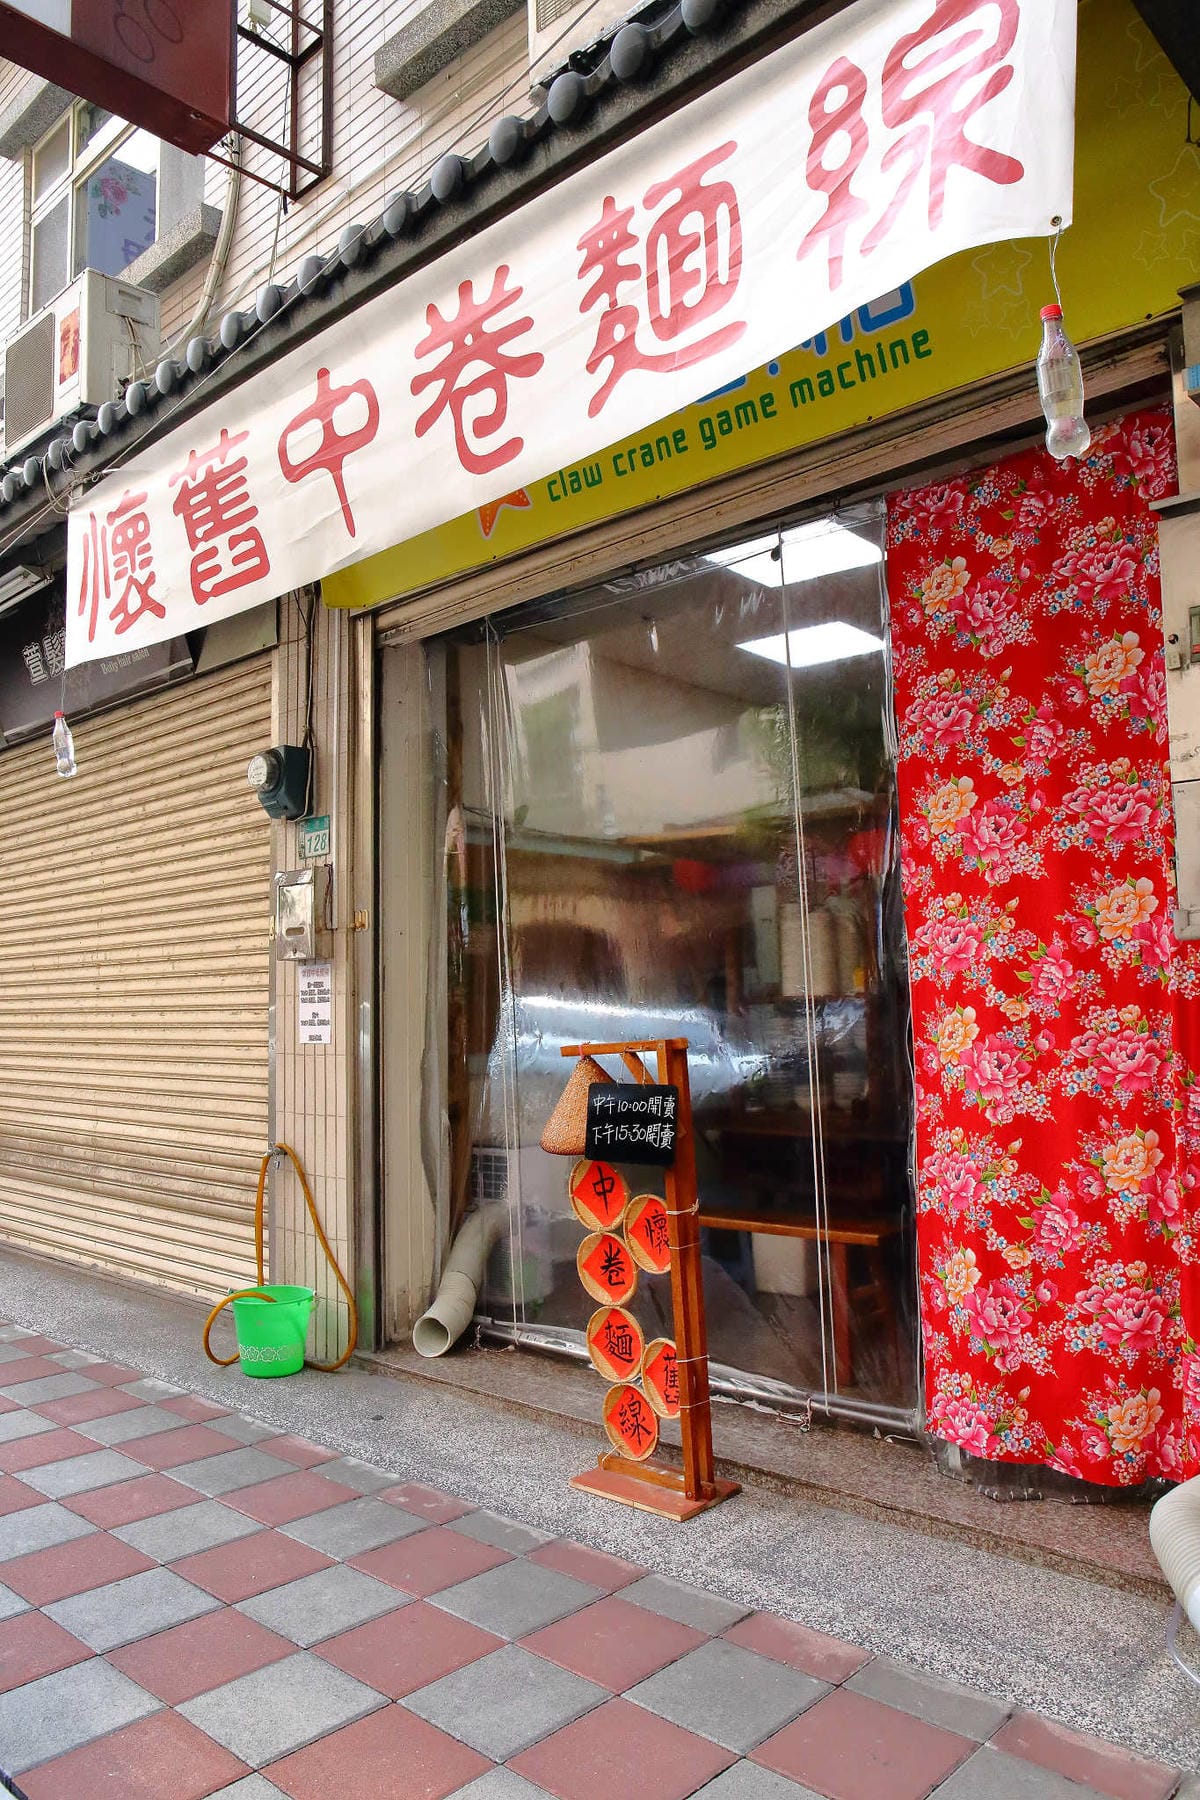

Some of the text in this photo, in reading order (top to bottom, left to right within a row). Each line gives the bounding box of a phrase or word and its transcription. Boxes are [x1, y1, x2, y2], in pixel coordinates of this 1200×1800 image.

[78, 0, 1025, 643] 懷舊中卷麵線
[546, 329, 933, 503] claw crane game machine
[307, 833, 327, 854] 128
